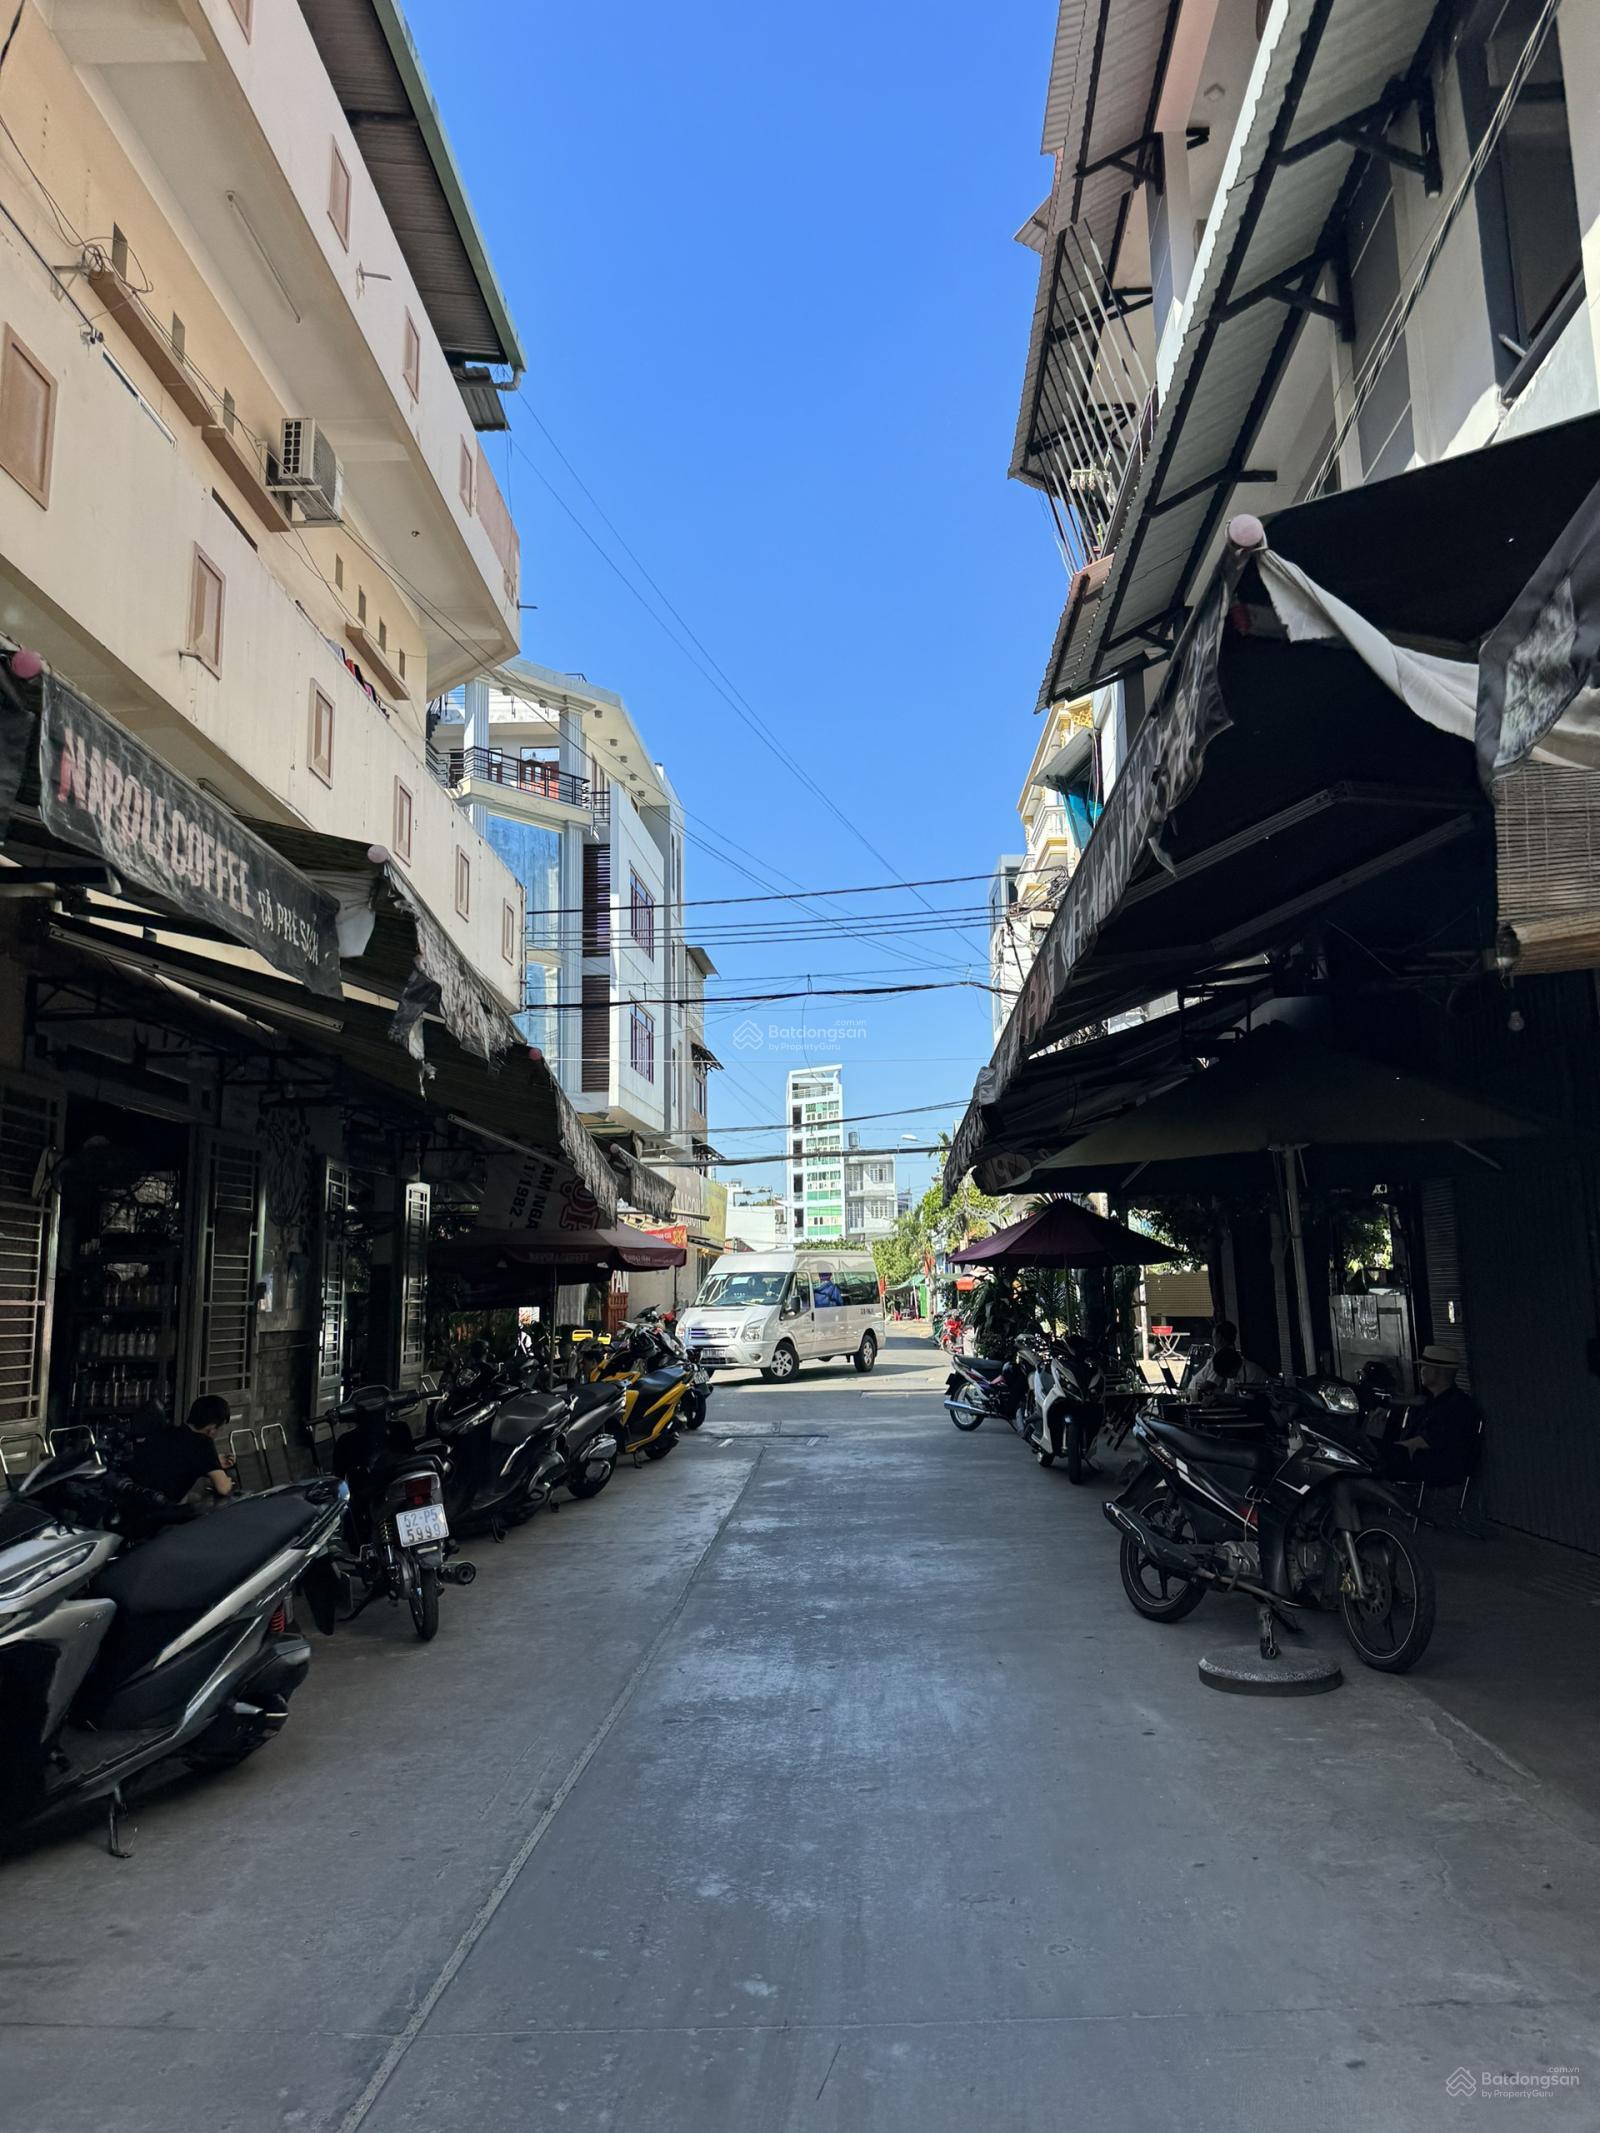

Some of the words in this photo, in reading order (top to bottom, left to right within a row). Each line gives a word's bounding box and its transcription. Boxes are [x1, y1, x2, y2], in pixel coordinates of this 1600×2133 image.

[57, 727, 166, 860] NAPOLI
[169, 809, 255, 919] COFFEE
[404, 1509, 438, 1528] 52-P5
[407, 1524, 441, 1543] 5999
